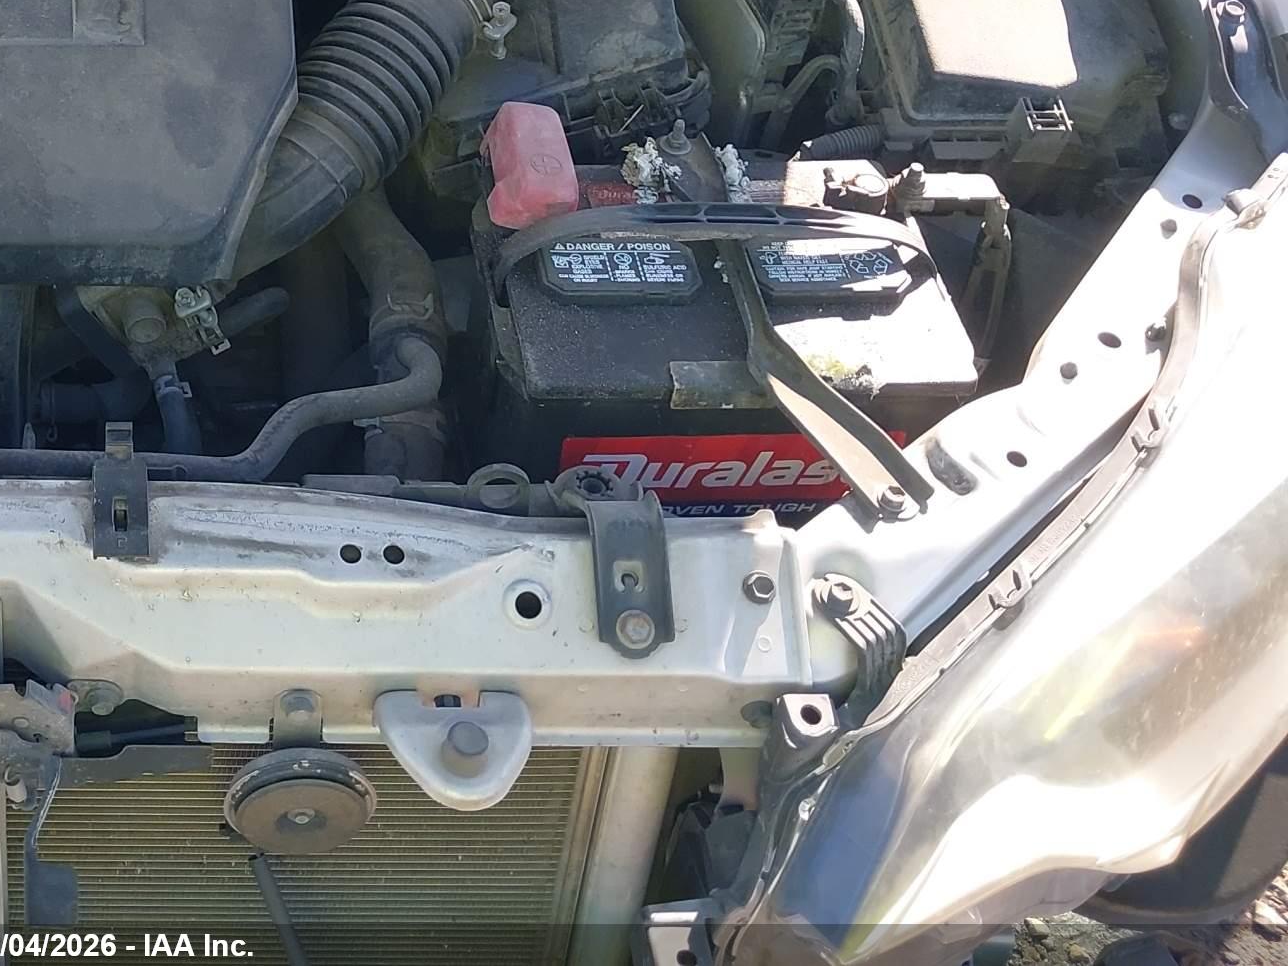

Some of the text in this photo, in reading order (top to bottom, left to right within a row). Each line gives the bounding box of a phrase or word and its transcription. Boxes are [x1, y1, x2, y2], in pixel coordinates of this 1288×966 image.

[565, 242, 671, 251] DANGER / POISON
[583, 451, 848, 488] Duralas
